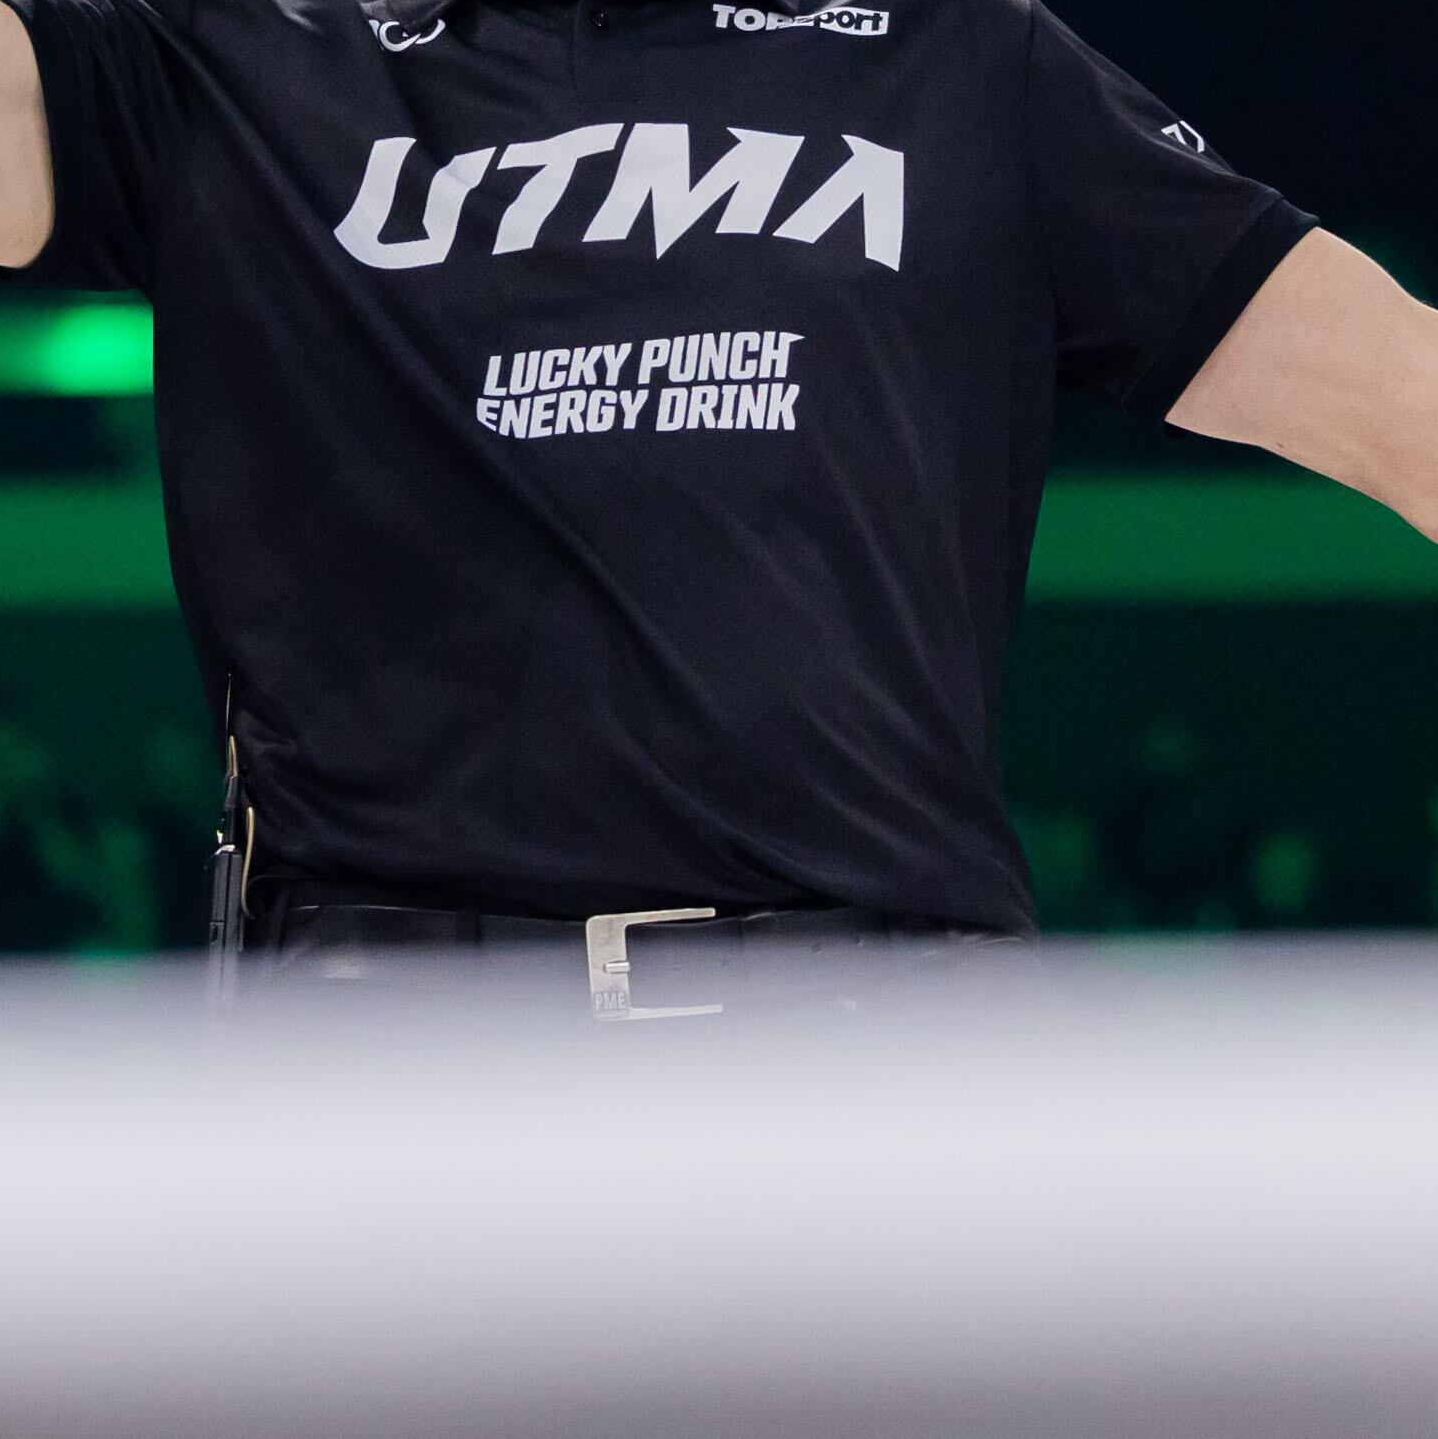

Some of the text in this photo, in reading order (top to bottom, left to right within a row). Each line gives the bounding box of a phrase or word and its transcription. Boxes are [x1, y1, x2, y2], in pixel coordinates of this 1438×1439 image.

[333, 122, 905, 272] UTMA
[482, 330, 806, 396] LUCKY PUNCH
[476, 383, 800, 439] ENERGY DRINK
[594, 992, 626, 1011] PME
